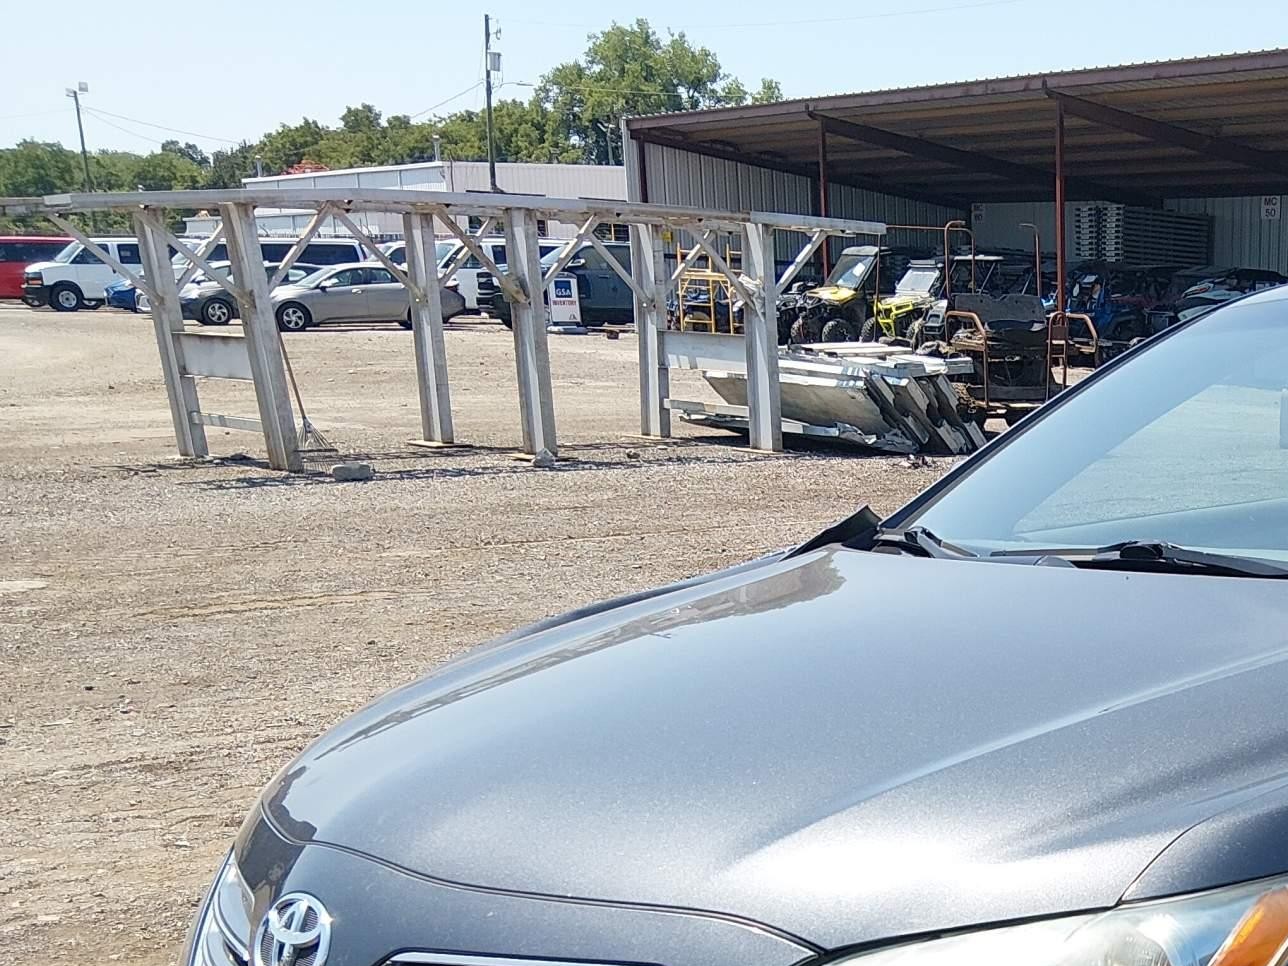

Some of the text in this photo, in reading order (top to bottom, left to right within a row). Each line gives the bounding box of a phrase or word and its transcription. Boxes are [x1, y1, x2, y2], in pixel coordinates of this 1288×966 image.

[1264, 196, 1278, 206] MC
[1264, 208, 1276, 217] 50
[555, 288, 571, 296] GSA
